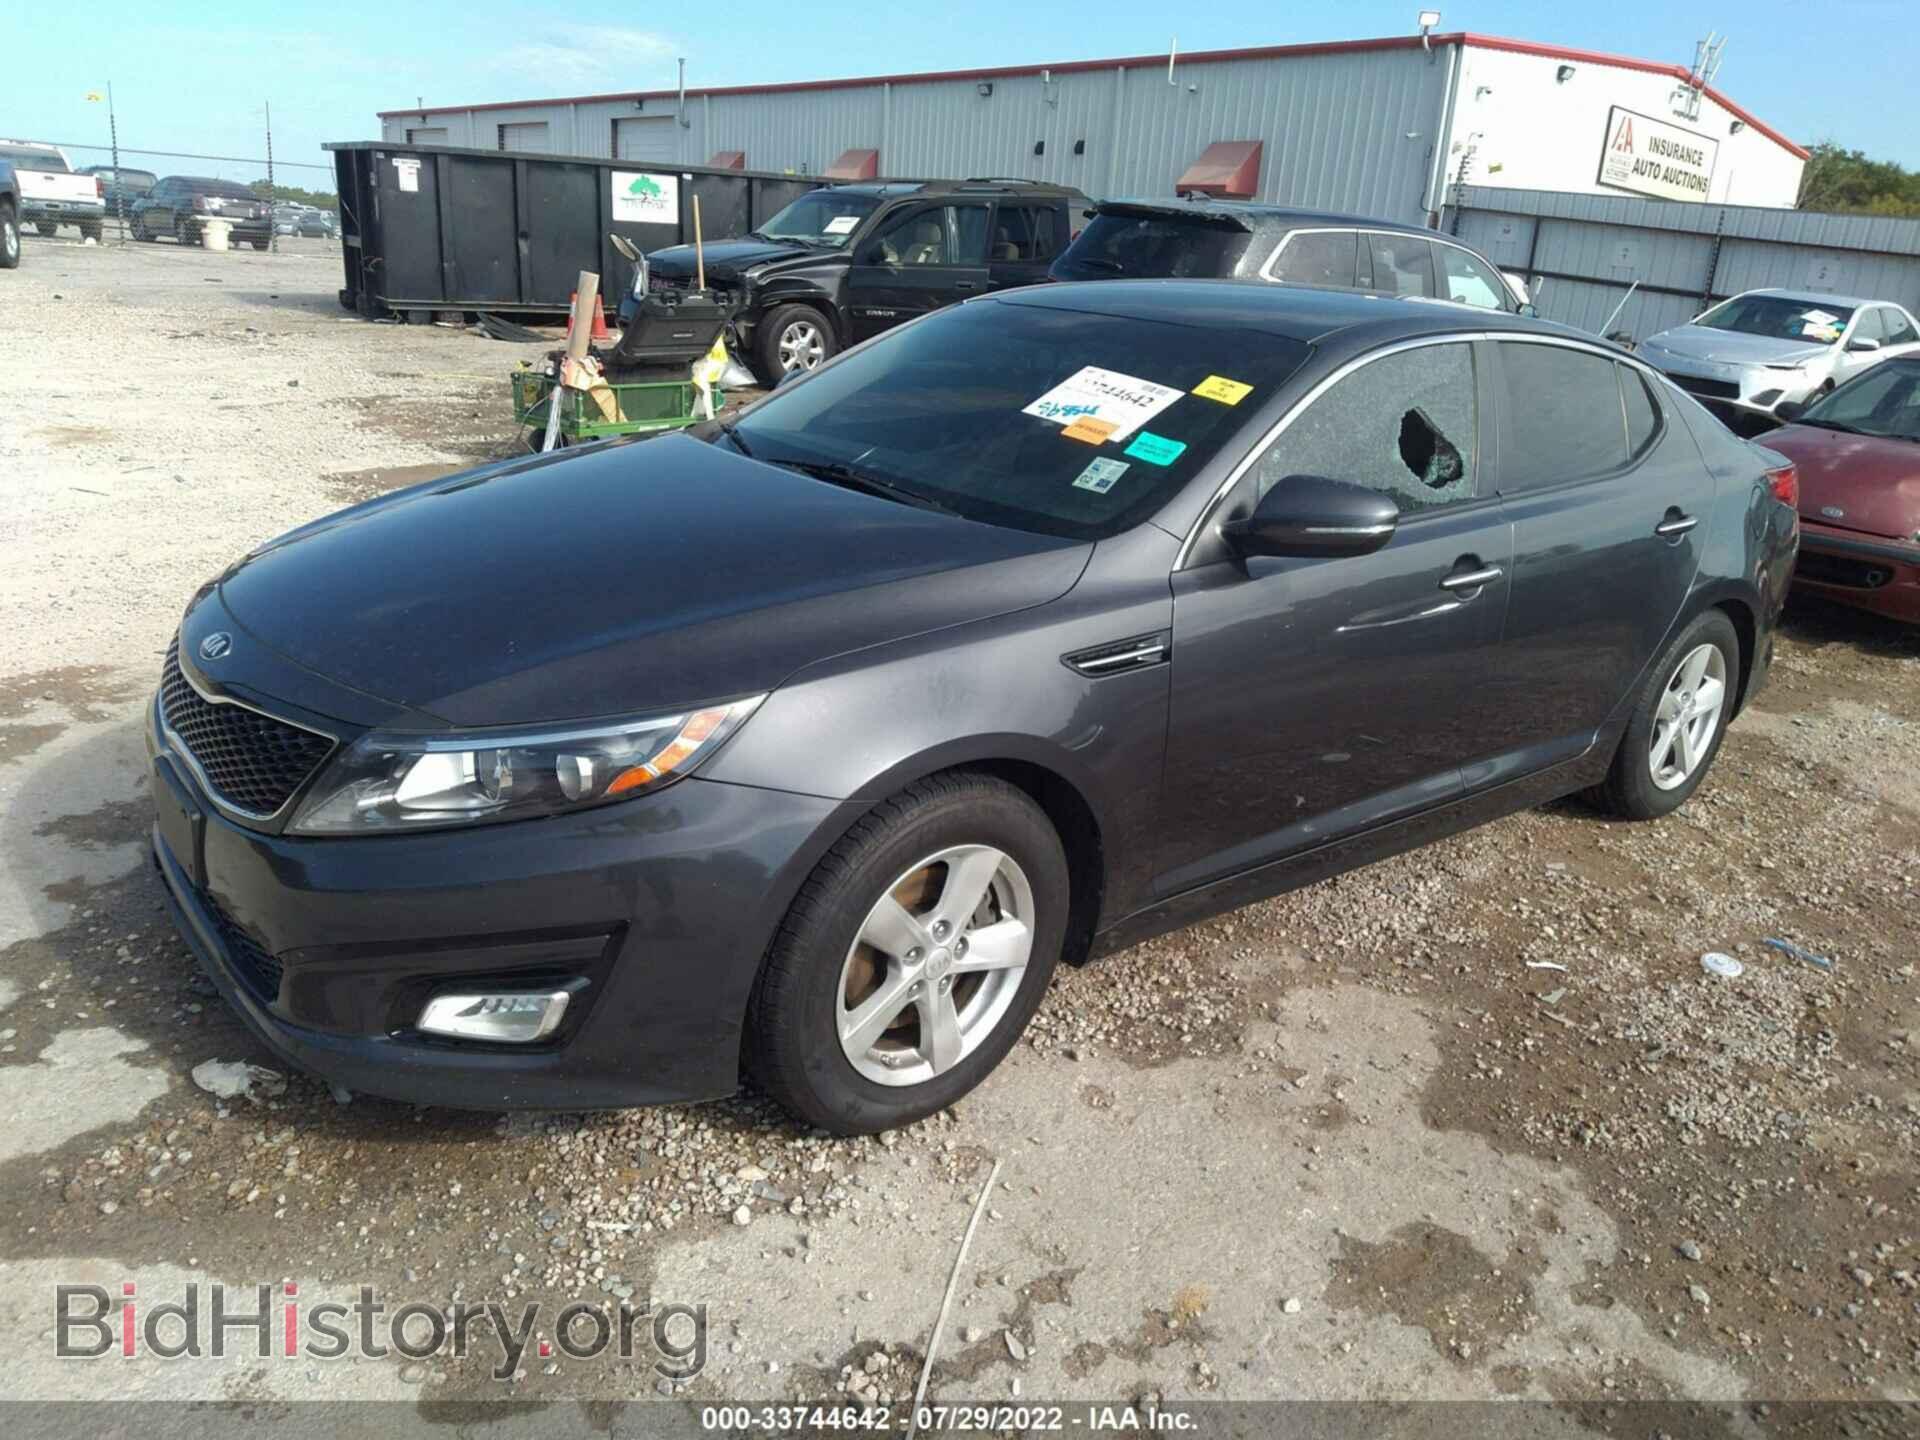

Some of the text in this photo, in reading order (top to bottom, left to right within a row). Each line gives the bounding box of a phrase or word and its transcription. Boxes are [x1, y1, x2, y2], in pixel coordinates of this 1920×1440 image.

[1649, 136, 1704, 167] INSURANCE
[1632, 158, 1660, 180] AUTO
[1661, 166, 1708, 193] AUCTIONS
